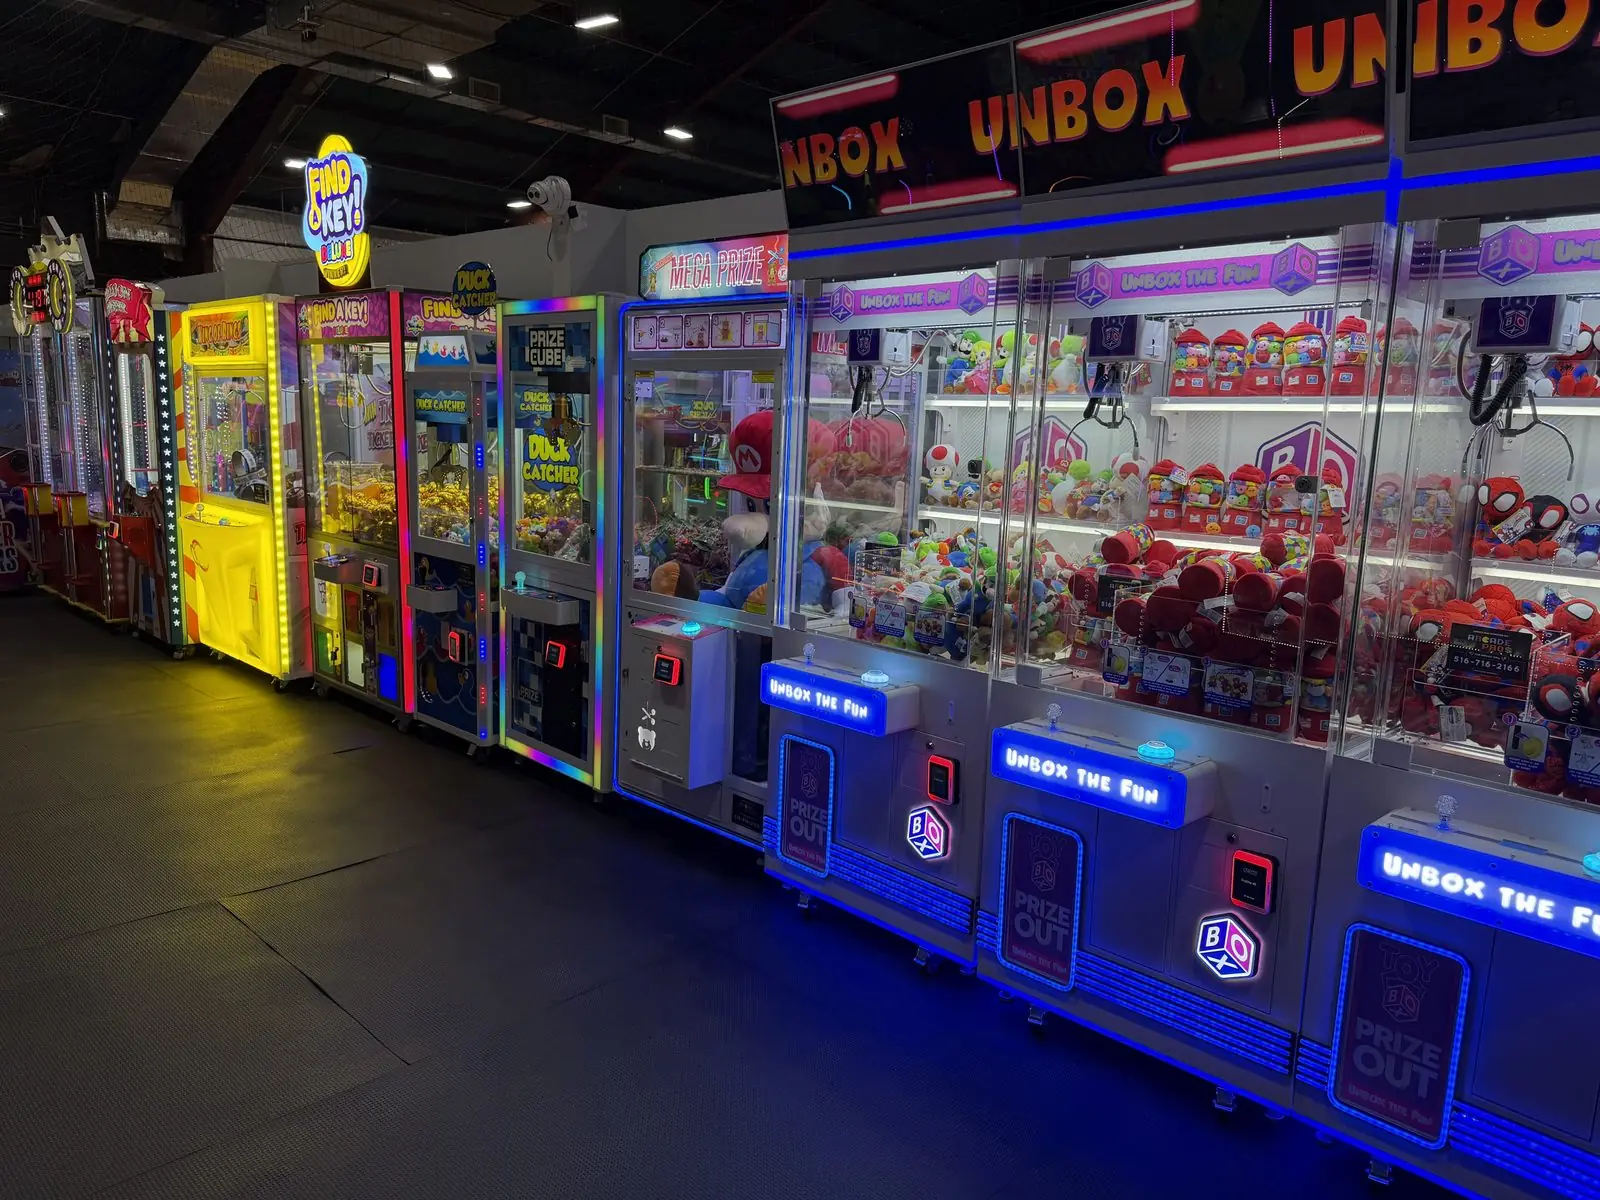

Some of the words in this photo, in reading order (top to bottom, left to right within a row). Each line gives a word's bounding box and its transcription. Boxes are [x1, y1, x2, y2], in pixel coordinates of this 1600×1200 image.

[1294, 0, 1600, 98] UNBO
[968, 54, 1191, 155] UNBOX
[309, 159, 351, 202] FIND
[322, 179, 361, 237] KEY!
[321, 240, 352, 263] DELUXE
[457, 269, 490, 292] DUCK
[670, 252, 712, 291] MEGA
[716, 245, 765, 289] PRIZE
[1121, 271, 1181, 293] UNBOX
[1186, 267, 1218, 288] THE
[1224, 263, 1260, 286] FUN
[452, 292, 497, 308] CATCHER
[861, 294, 901, 311] UNBOX
[904, 292, 925, 307] THE
[928, 288, 952, 306] FUN
[530, 329, 565, 348] PRIZE
[434, 399, 467, 413] CATCHER
[524, 391, 551, 403] DUCK
[528, 434, 571, 462] DUCK
[523, 462, 579, 485] CATCHER
[1467, 634, 1513, 646] ARCADE
[1453, 655, 1520, 673] 516-716-2166
[770, 678, 811, 702] UNBOX
[815, 691, 838, 710] THE
[843, 698, 868, 718] FUN
[1006, 747, 1068, 779] UNBOX
[1077, 768, 1111, 792] THE
[1120, 778, 1159, 804] FUN
[790, 797, 829, 823] PRIZE
[790, 815, 828, 847] OUT
[1383, 852, 1485, 899] UNBOX
[1499, 886, 1555, 919] THE
[1015, 889, 1071, 928] PRIZE
[1014, 911, 1070, 953] OUT
[1206, 926, 1248, 971] BOX
[1354, 1016, 1443, 1072] PRIZE
[1352, 1045, 1441, 1099] OUT
